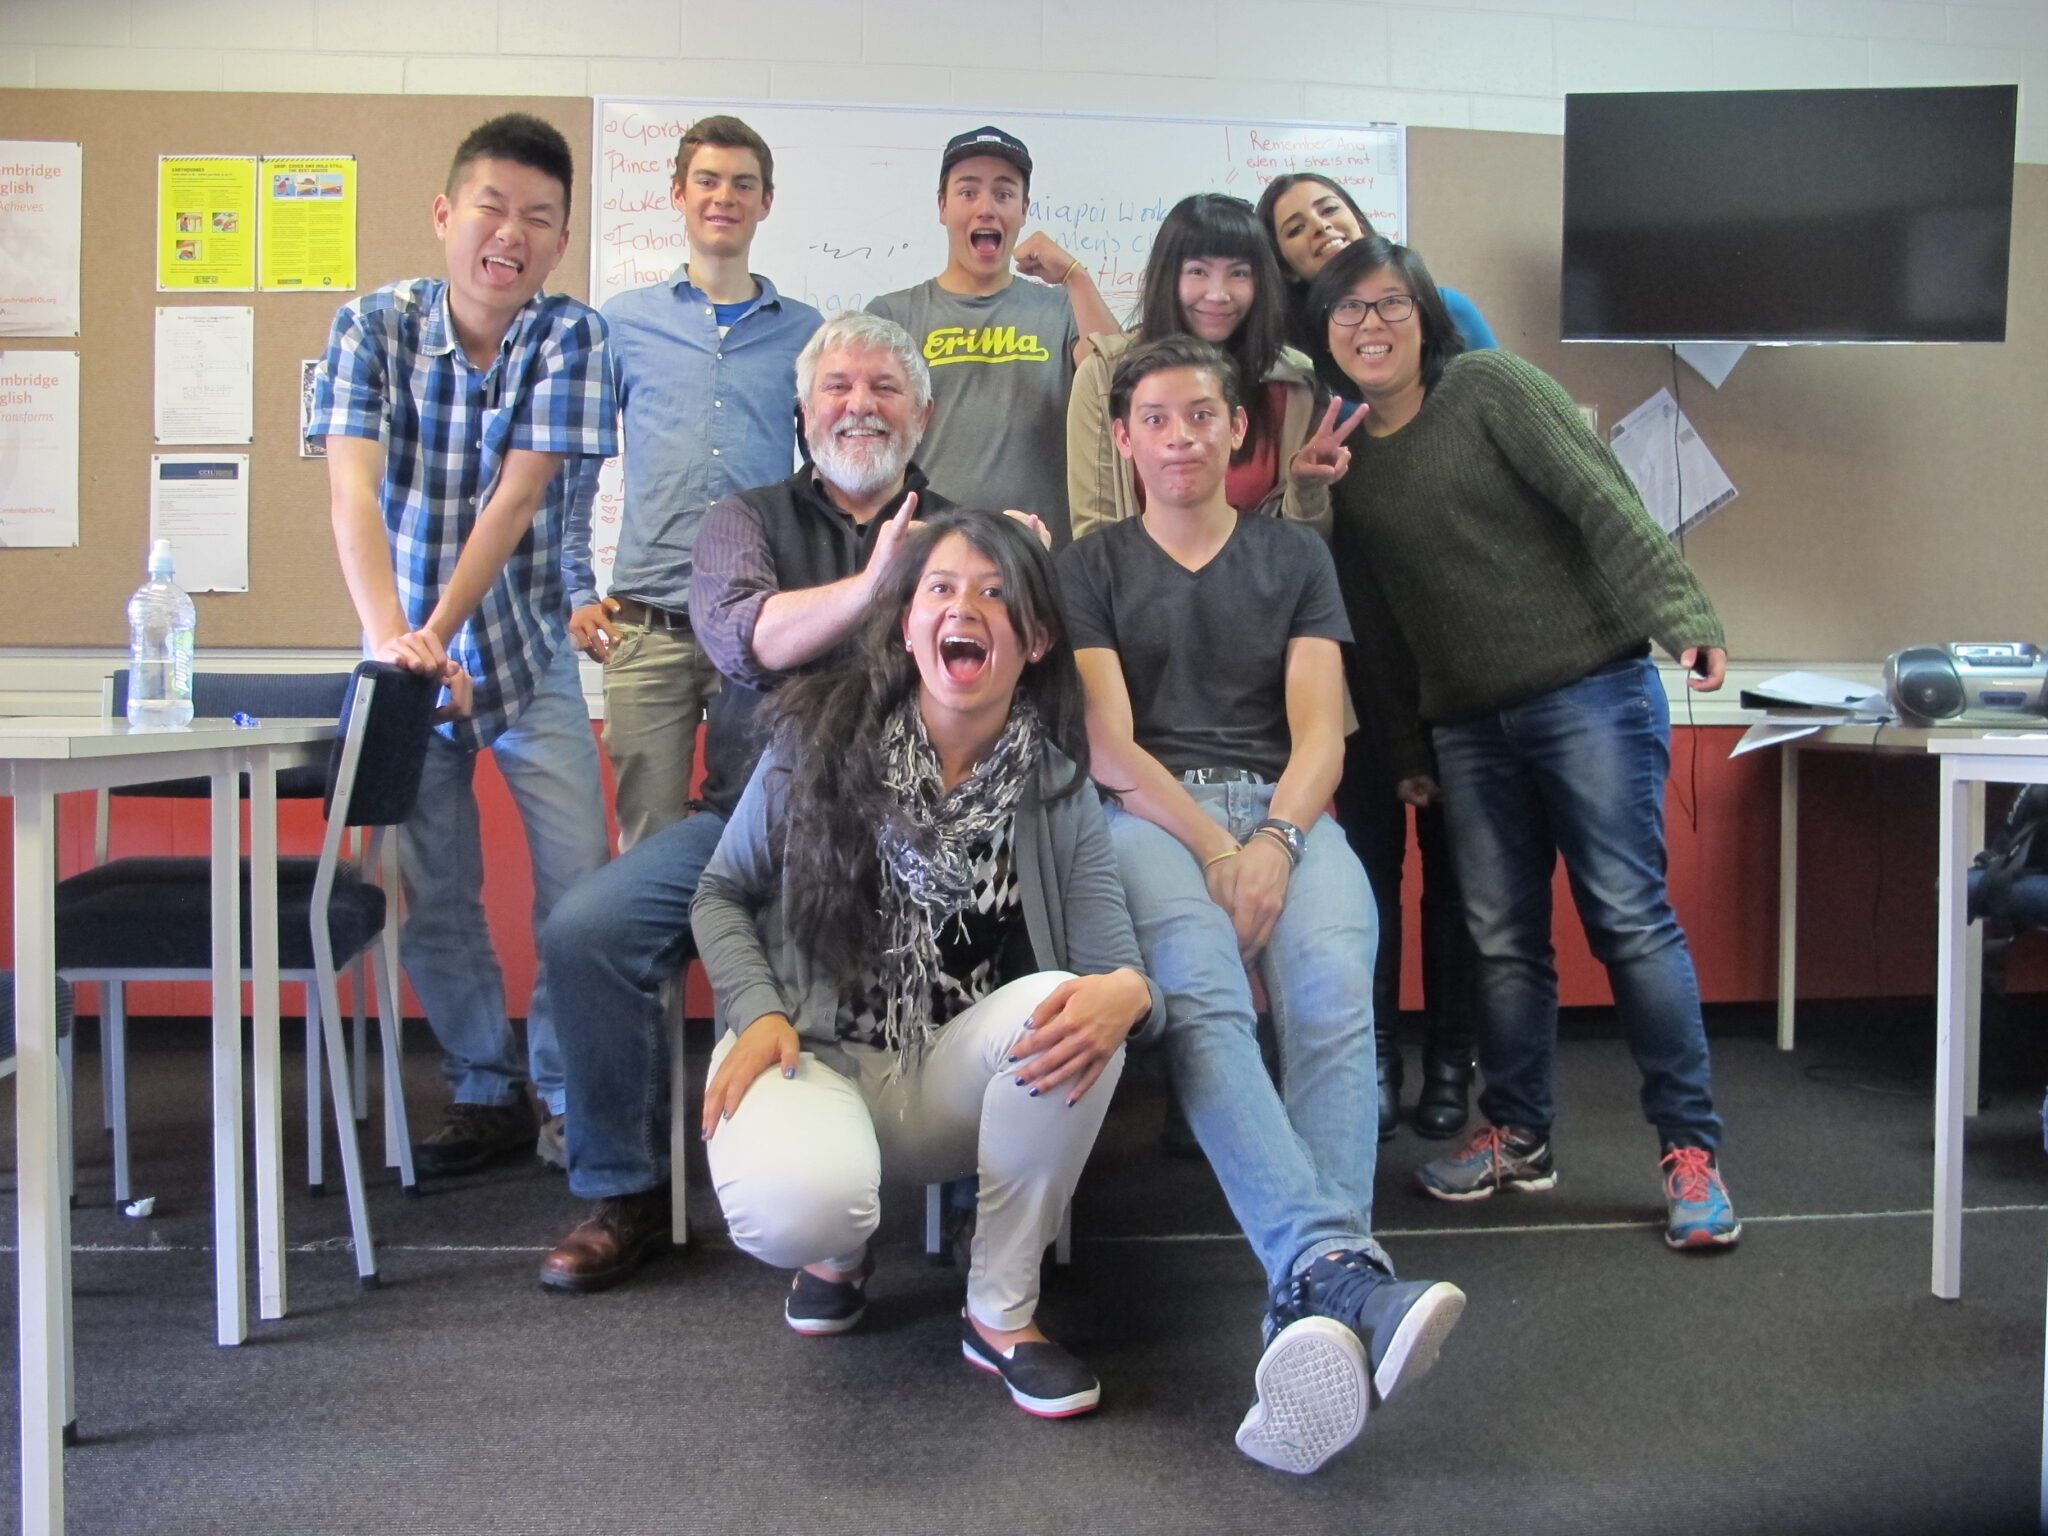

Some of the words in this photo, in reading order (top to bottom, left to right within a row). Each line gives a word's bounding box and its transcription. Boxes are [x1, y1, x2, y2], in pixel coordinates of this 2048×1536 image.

[1250, 129, 1328, 151] Remember
[1347, 152, 1371, 165] not
[0, 163, 62, 179] mbridge
[0, 181, 34, 197] glish
[1028, 195, 1106, 228] aiapoi
[611, 222, 687, 256] Fabiol
[0, 373, 60, 390] mbridge
[0, 391, 32, 407] glish
[0, 410, 55, 424] ransforms
